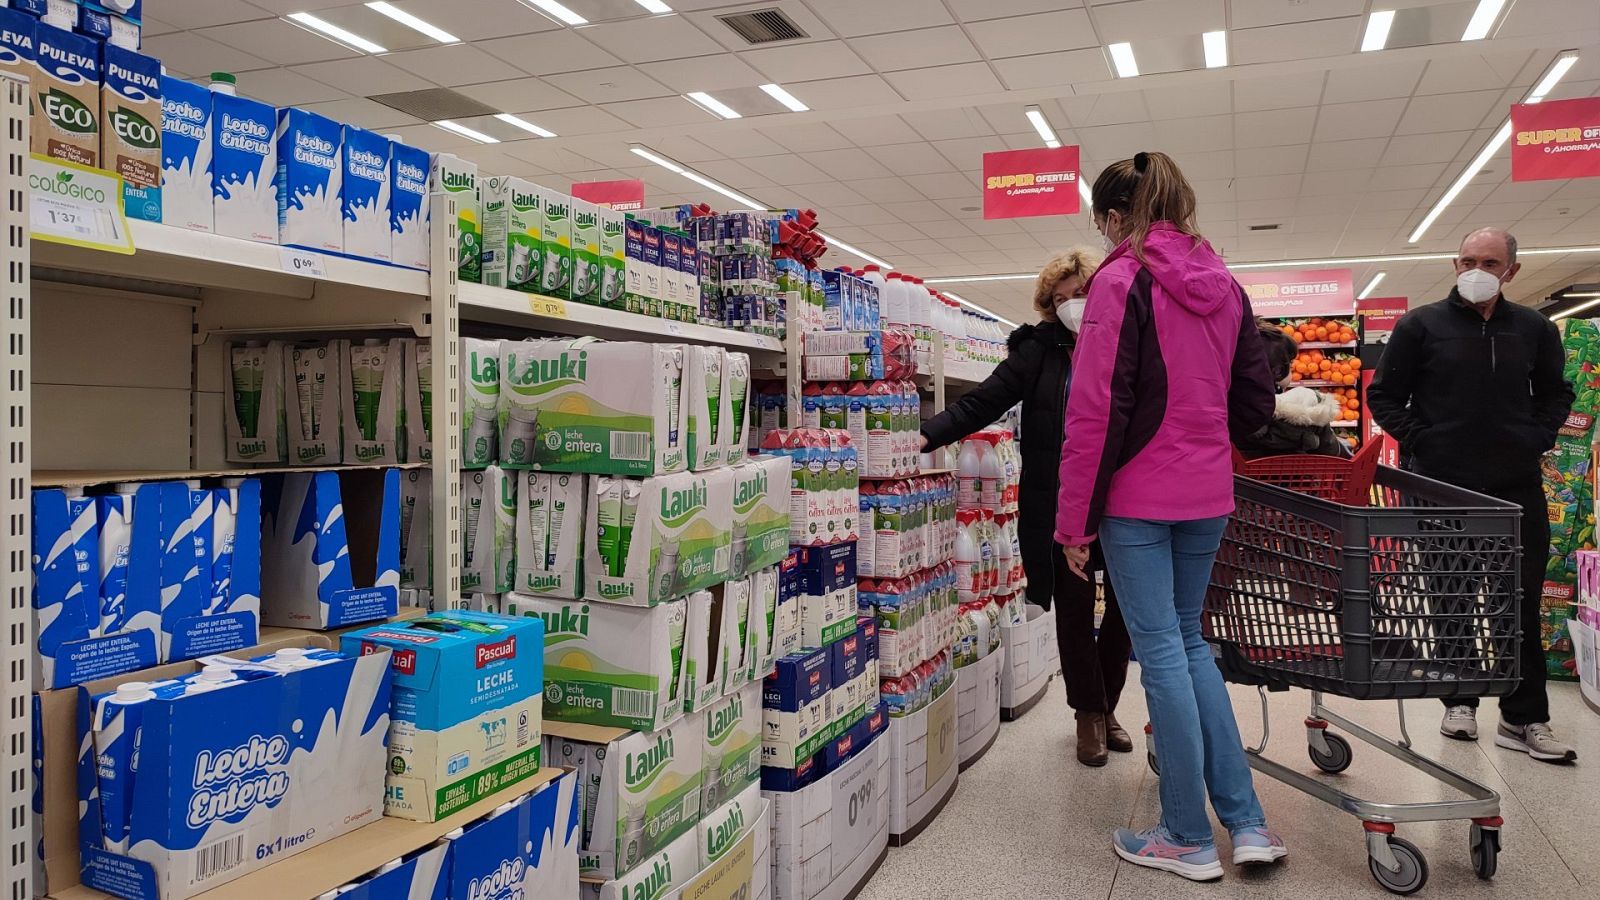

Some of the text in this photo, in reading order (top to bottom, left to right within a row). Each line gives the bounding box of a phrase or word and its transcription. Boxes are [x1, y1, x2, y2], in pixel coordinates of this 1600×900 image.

[39, 42, 96, 71] PULEVA
[109, 63, 159, 90] PULEVA
[45, 95, 93, 128] ECO
[161, 96, 204, 122] Leche
[114, 112, 157, 143] ECO
[161, 115, 206, 140] Entera
[223, 114, 268, 138] Leche
[1517, 128, 1582, 145] SUPER
[220, 132, 271, 156] Entera
[296, 130, 334, 153] Leche
[295, 148, 336, 170] Entera
[349, 145, 384, 167] Leche
[349, 161, 386, 182] Entera
[397, 159, 425, 181] Leche
[441, 167, 475, 189] Lauki
[987, 173, 1075, 189] SUPER OFERTAS
[125, 187, 148, 199] ENTERA
[396, 176, 427, 195] Entera
[512, 189, 540, 208] Lauki
[544, 199, 569, 218] Lauki
[611, 202, 641, 211] OFERTAS
[574, 208, 597, 226] Lauki
[602, 217, 624, 233] Lauki
[1280, 283, 1339, 296] OFERTAS
[507, 350, 588, 385] Lauki
[564, 429, 583, 440] leche
[236, 440, 267, 454] Lauki
[297, 443, 326, 458] Lauki
[355, 443, 386, 458] Lauki
[564, 439, 603, 453] entera
[661, 478, 707, 519] Lauki
[733, 471, 768, 507] Lauki
[692, 562, 711, 576] entera
[527, 573, 561, 588] Lauki
[597, 580, 634, 596] Lauki
[80, 642, 98, 652] LECHE
[782, 632, 797, 646] LECHE
[70, 651, 90, 661] Origen
[479, 639, 514, 663] Pascual
[844, 659, 857, 671] LECHE
[476, 669, 514, 693] LECHE
[566, 684, 585, 695] leche
[469, 683, 519, 705] SEMIDESNATADA
[566, 694, 604, 709] entera
[707, 692, 743, 739] Lauki
[195, 736, 287, 788] Leche
[505, 755, 528, 772] MATERIAL
[528, 752, 535, 761] DE
[625, 729, 674, 785] Lauki
[477, 771, 498, 796] 89%
[500, 760, 538, 785] ORIGEN VEGETAL
[188, 770, 288, 828] Entera
[439, 791, 470, 814] SOSTENIBLE
[445, 784, 466, 801] ENVASE
[660, 810, 681, 833] entera
[707, 802, 744, 856] Lauki
[255, 833, 306, 861] 6x1 litro
[468, 857, 523, 900] Leche
[621, 852, 672, 900] Lauki
[694, 878, 711, 900] LECHE
